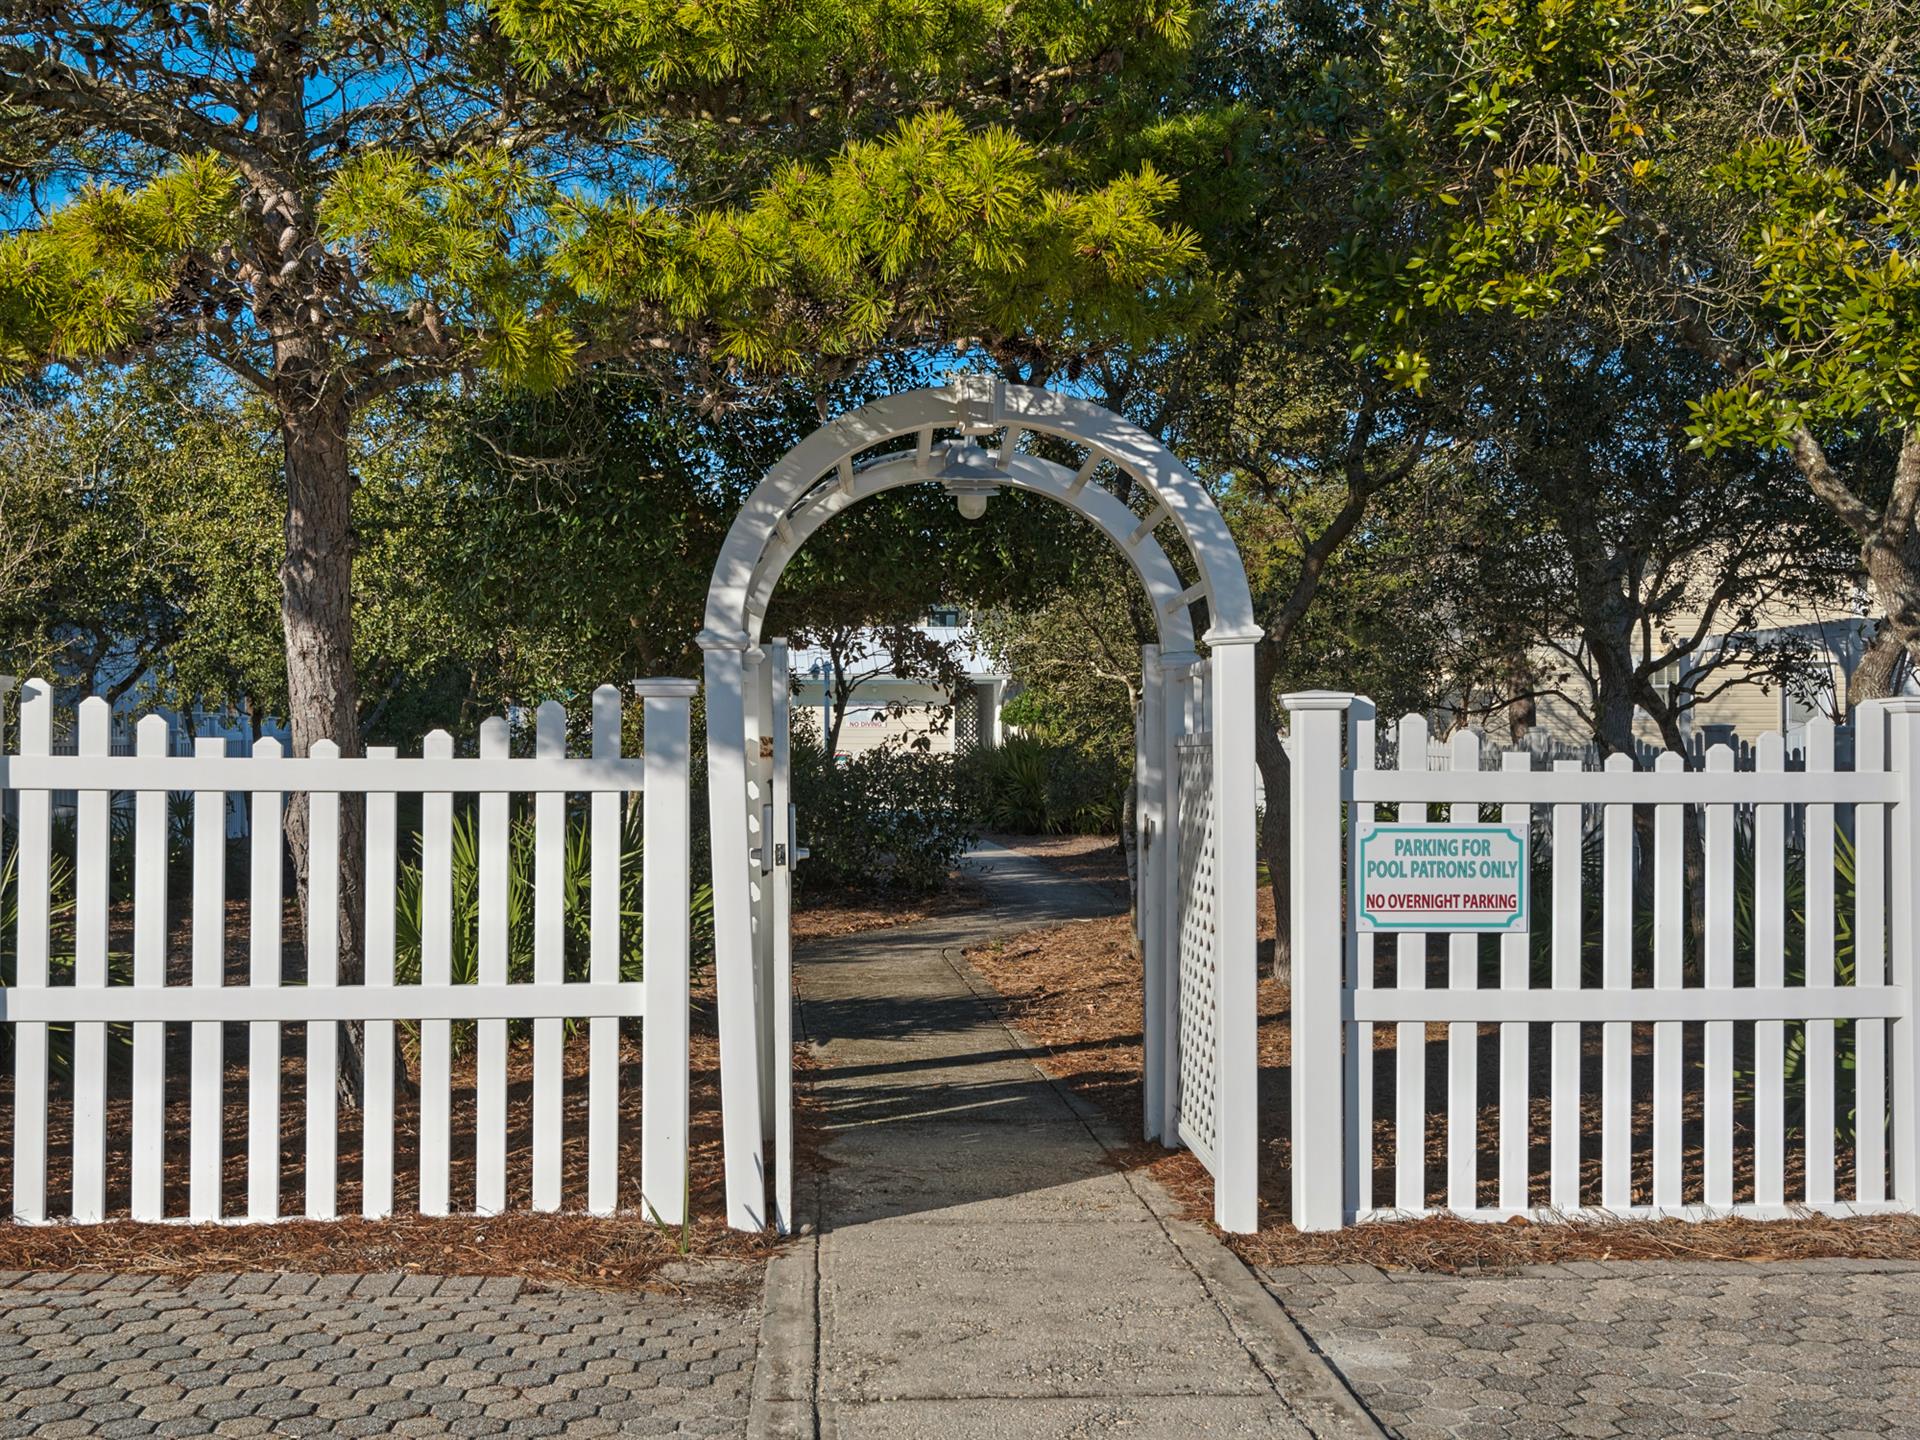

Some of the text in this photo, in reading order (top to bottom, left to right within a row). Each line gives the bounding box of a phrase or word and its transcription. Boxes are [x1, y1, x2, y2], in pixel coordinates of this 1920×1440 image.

[1394, 839, 1491, 856] PARKING FOR
[1367, 860, 1518, 878] POOL PATRONS ONLY
[1366, 894, 1517, 909] NO OVERNIGHT PARKING
